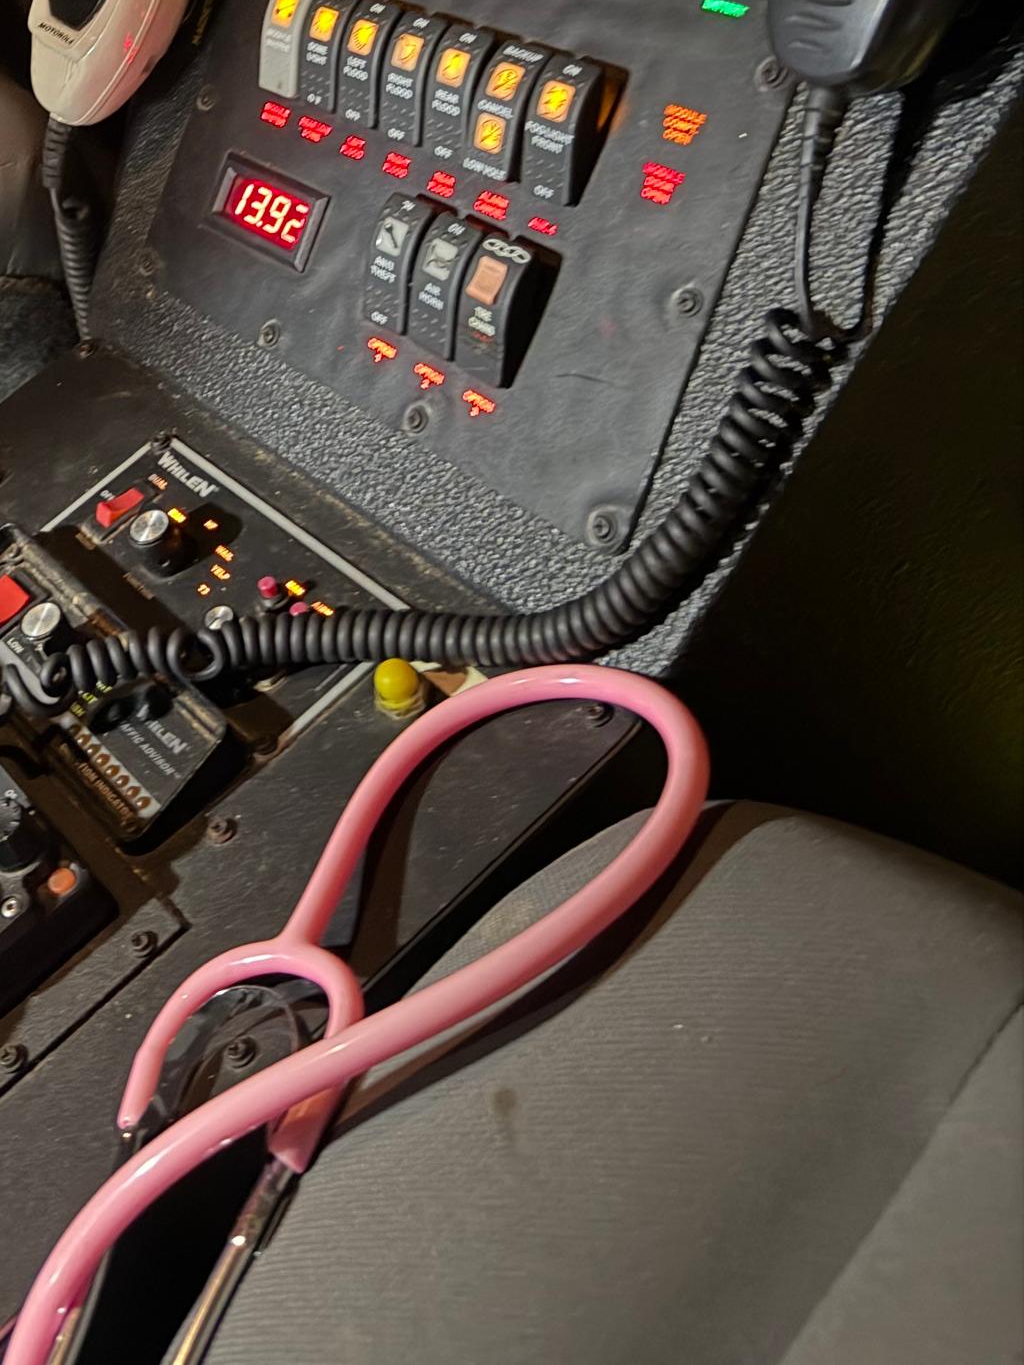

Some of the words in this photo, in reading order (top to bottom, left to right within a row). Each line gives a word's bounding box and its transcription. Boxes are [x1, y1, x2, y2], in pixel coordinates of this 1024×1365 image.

[370, 3, 386, 14] ON
[413, 17, 430, 29] ON
[459, 32, 477, 44] ON
[503, 45, 544, 62] BACKUP
[343, 66, 369, 82] FLOOD
[562, 64, 583, 77] ON
[388, 72, 414, 88] RIGHT
[386, 84, 413, 100] FLOOD
[435, 89, 460, 105] REAR
[432, 99, 461, 117] FLOOD
[477, 99, 514, 120] CANCEL
[387, 128, 406, 141] OFF
[434, 146, 453, 160] OFF
[534, 185, 554, 200] OFF
[447, 223, 466, 236] ON
[371, 311, 388, 325] OFF
[6, 637, 25, 654] LOW
[140, 743, 176, 775] ADVISOR
